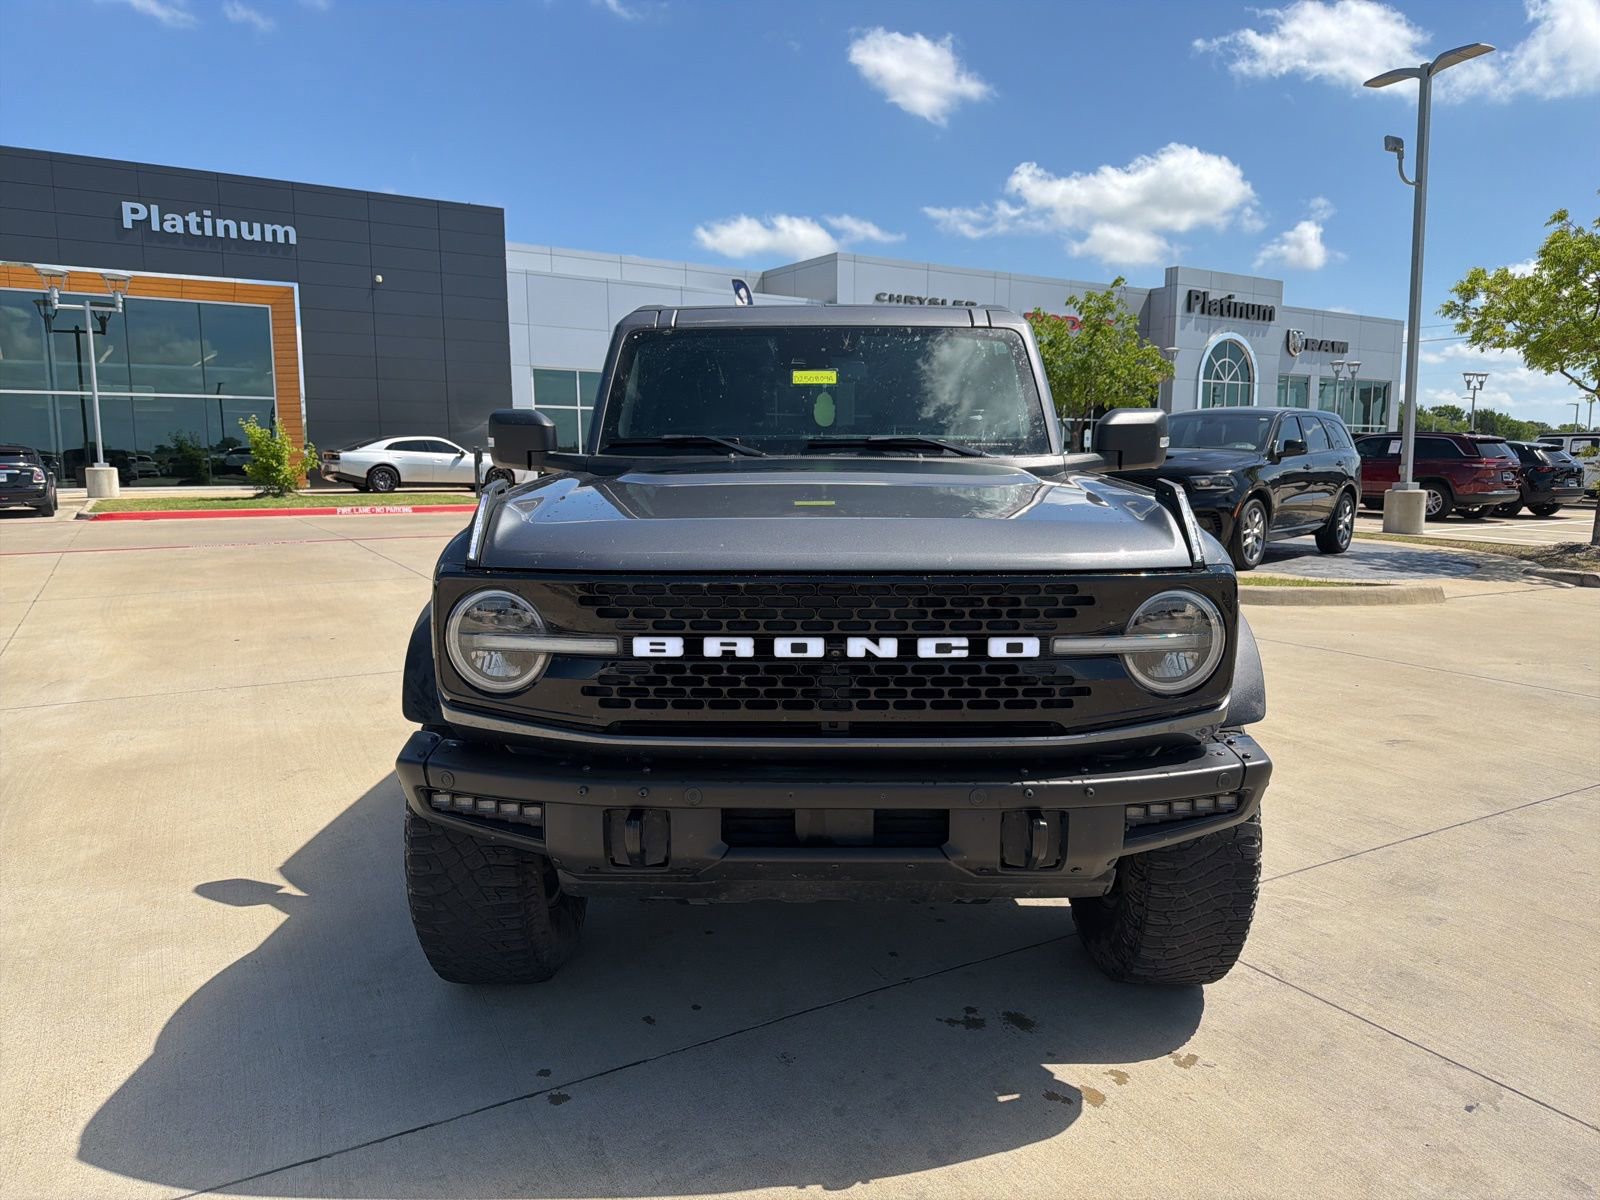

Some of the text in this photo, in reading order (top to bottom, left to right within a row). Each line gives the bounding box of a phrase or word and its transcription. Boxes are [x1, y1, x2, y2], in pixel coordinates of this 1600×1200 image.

[121, 200, 297, 245] Platinum
[1187, 289, 1275, 322] Platinum
[1304, 338, 1349, 354] RAM
[632, 636, 1040, 658] BRONCO
